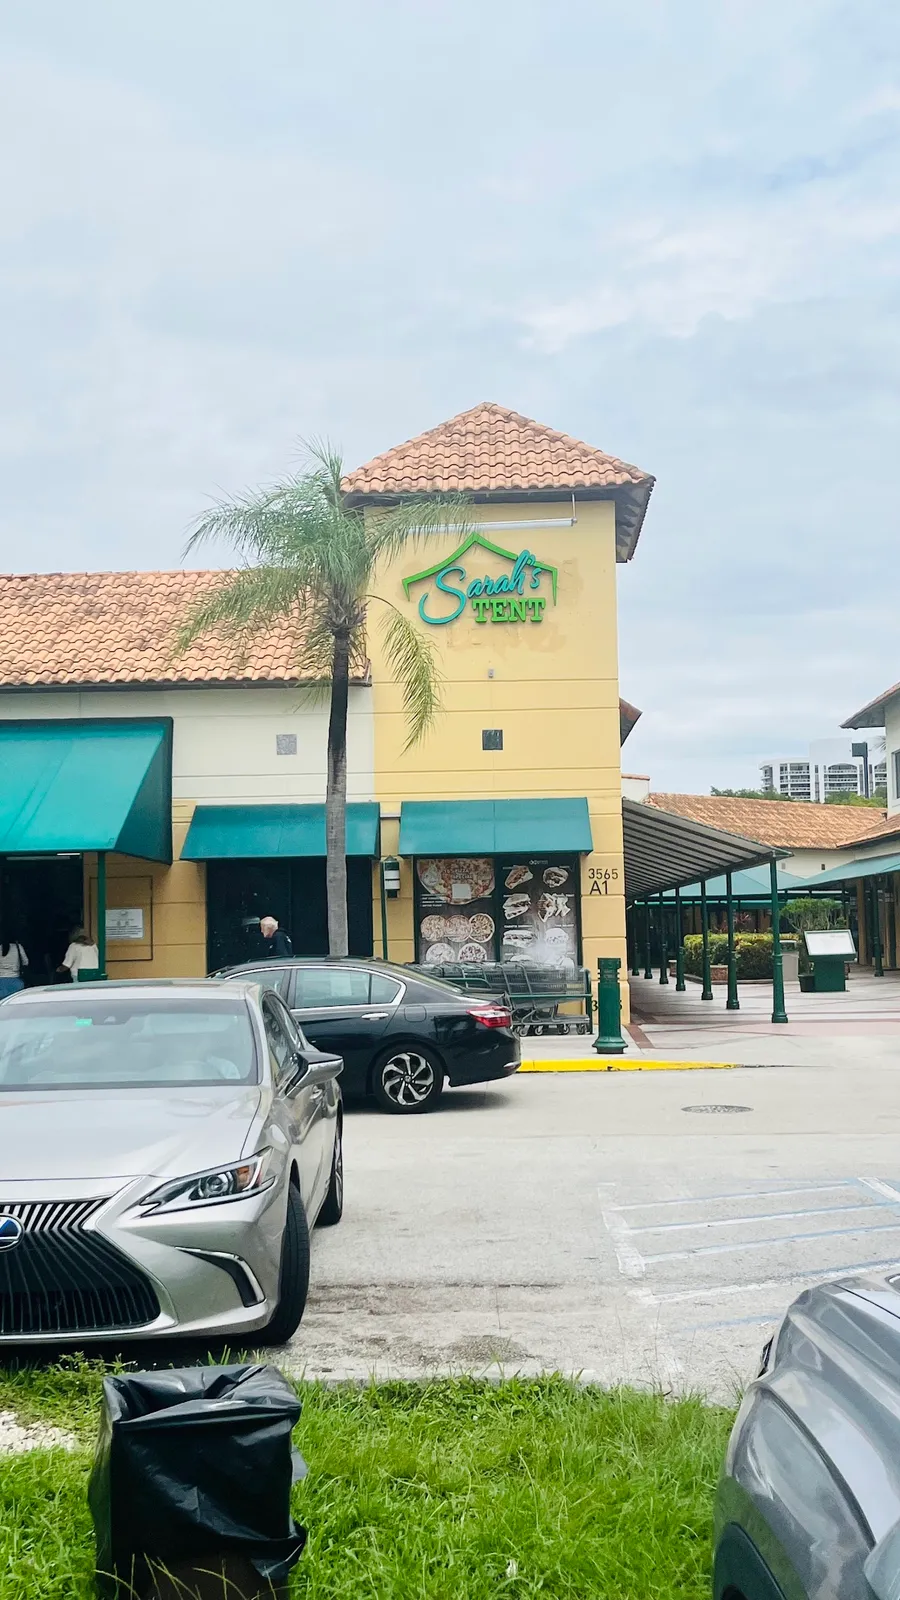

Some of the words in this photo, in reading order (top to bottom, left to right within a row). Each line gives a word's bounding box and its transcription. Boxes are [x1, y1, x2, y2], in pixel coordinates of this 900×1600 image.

[418, 549, 542, 625] Sarah's
[472, 598, 546, 623] TENT
[588, 868, 619, 880] 3565
[589, 880, 608, 895] A1
